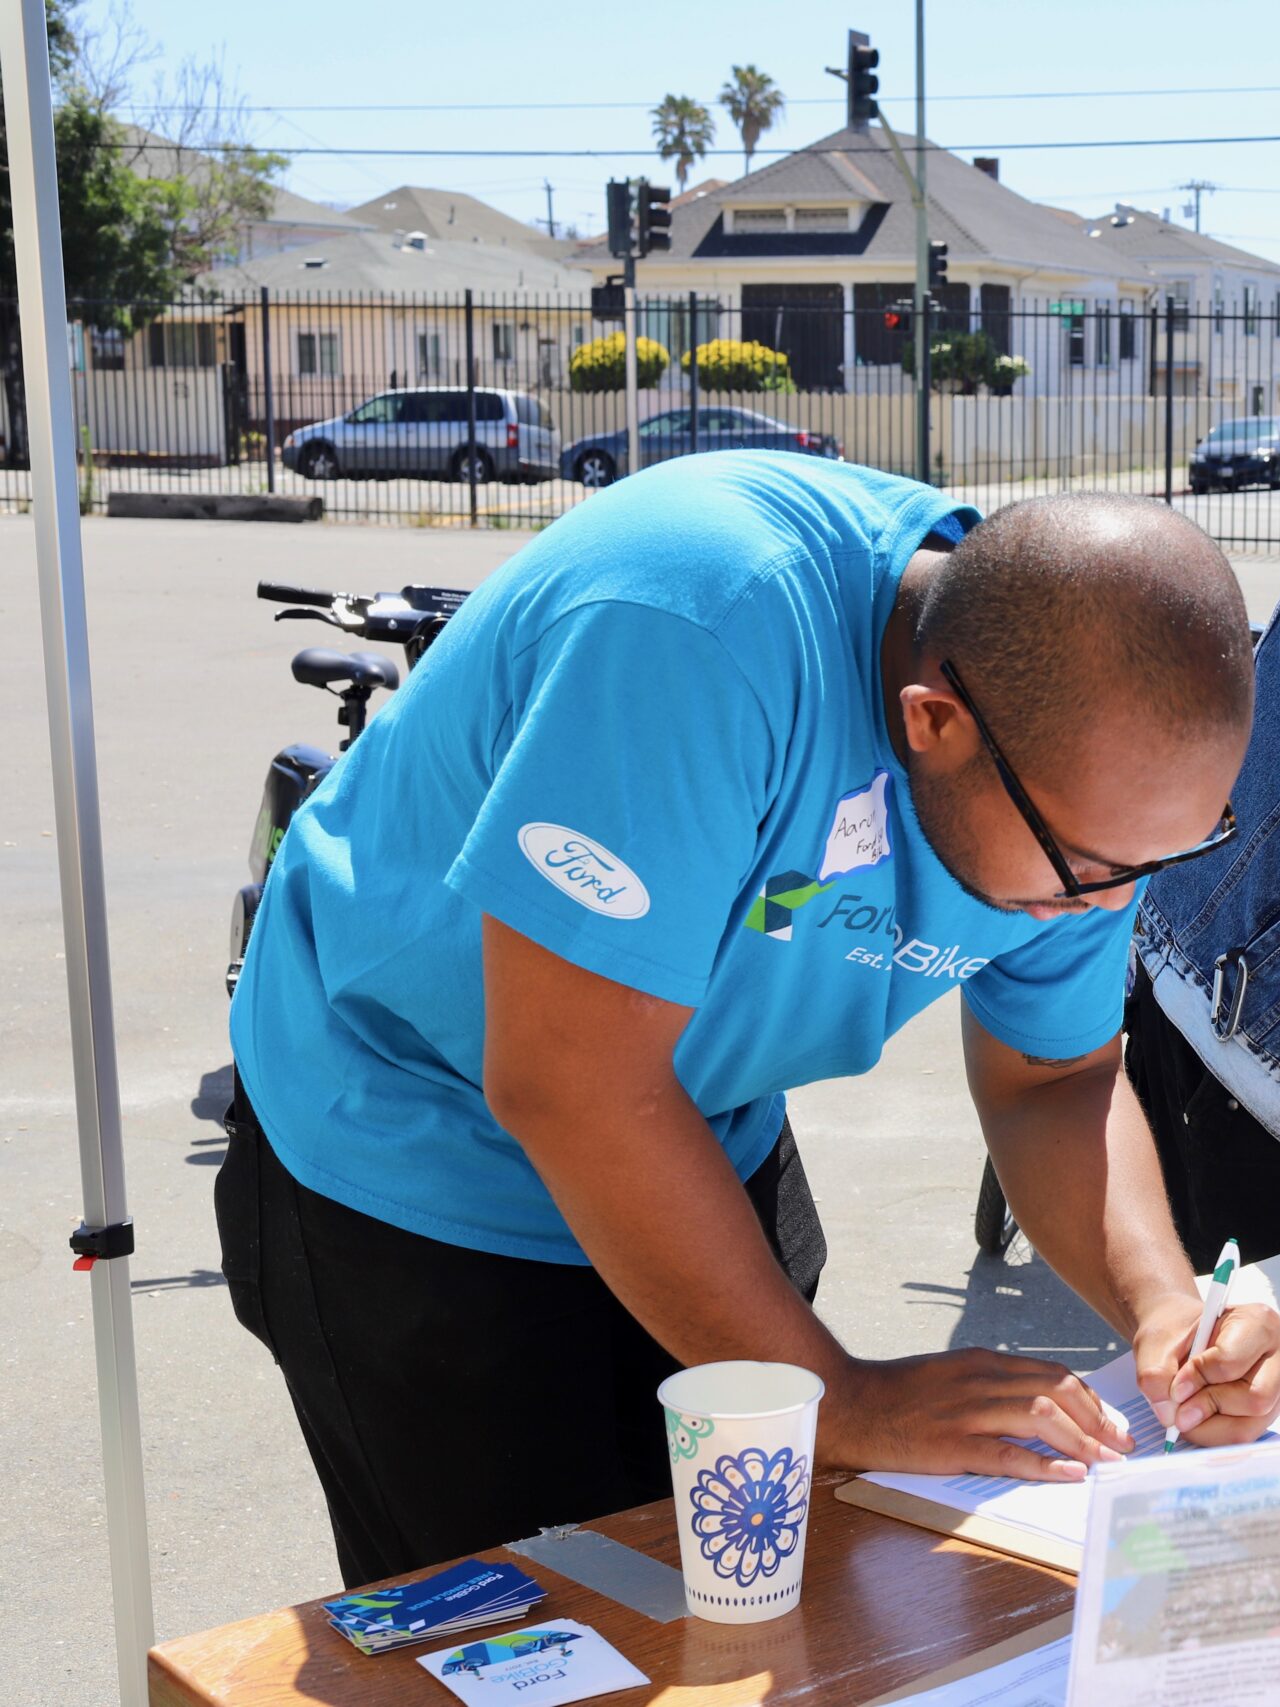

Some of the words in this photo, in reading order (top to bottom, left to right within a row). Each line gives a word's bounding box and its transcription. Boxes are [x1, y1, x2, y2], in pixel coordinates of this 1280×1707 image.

[545, 841, 628, 905] Ford
[845, 946, 882, 969] Est.
[491, 1658, 568, 1683] GoBike
[512, 1669, 567, 1691] Ford
